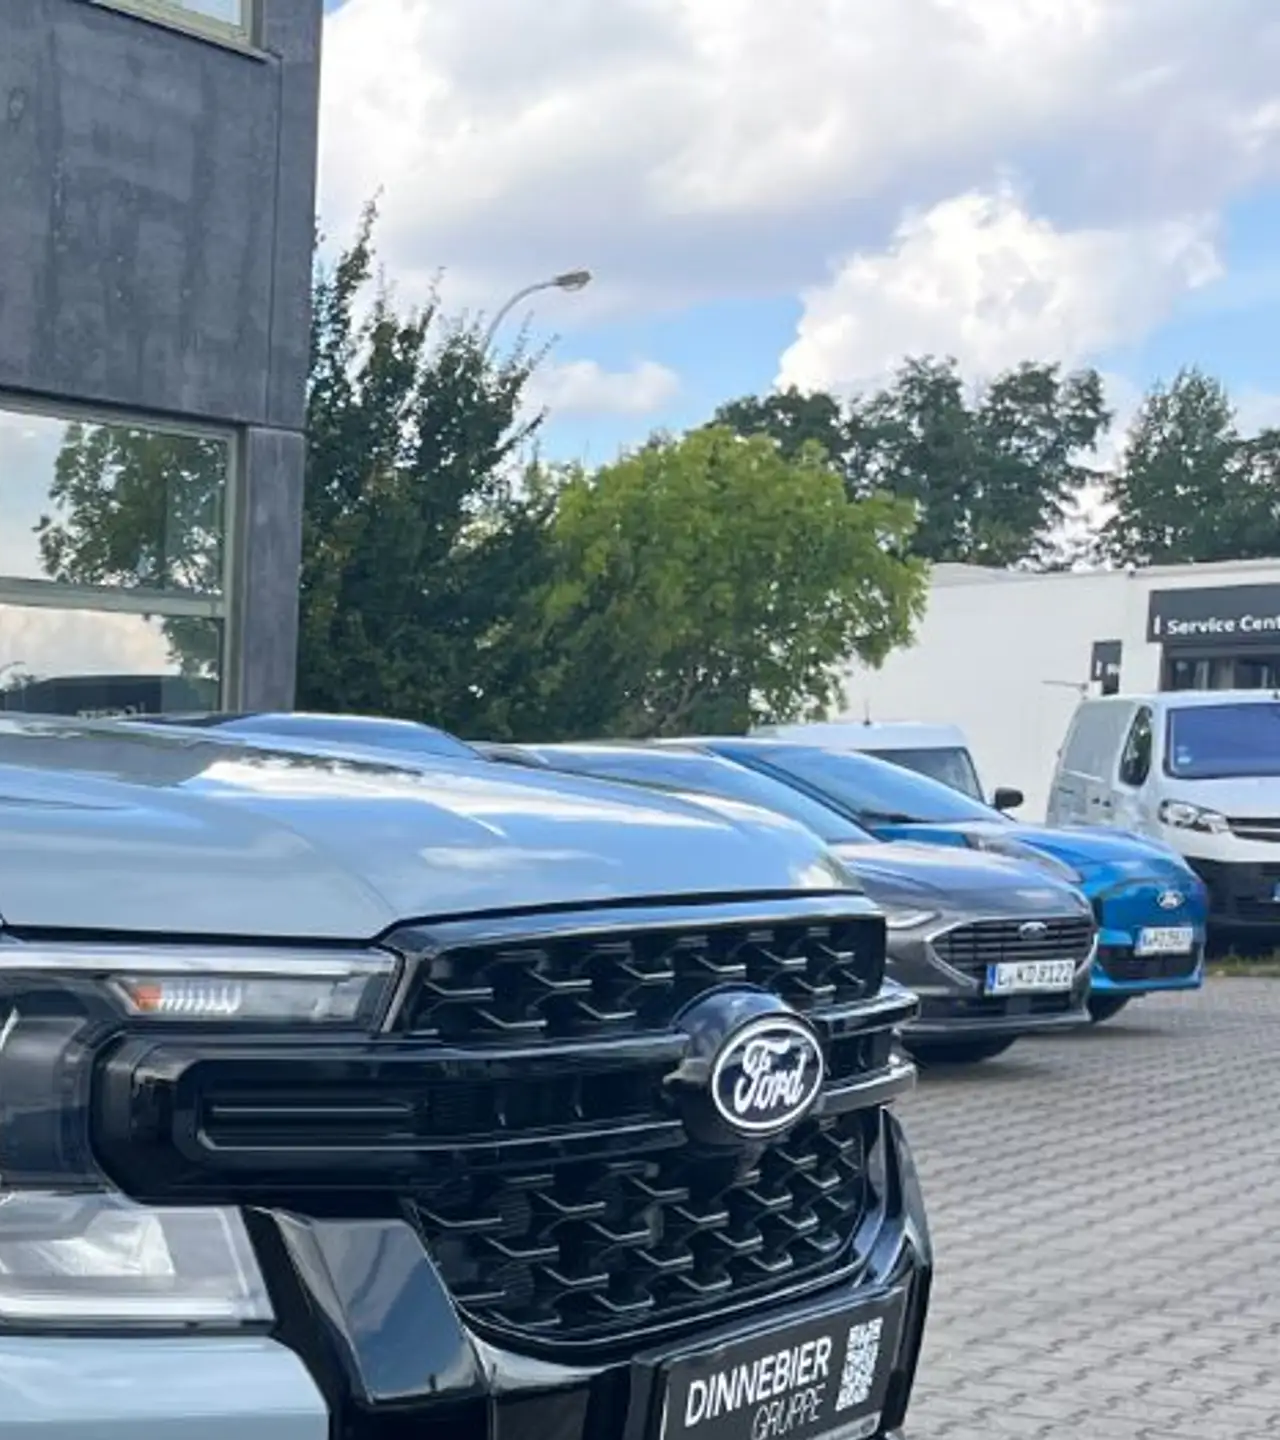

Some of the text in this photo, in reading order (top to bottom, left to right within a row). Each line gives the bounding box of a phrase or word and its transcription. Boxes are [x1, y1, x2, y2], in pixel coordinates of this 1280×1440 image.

[1167, 616, 1236, 635] Service
[733, 1038, 807, 1115] Ford
[684, 1335, 833, 1428] DINNEBIER
